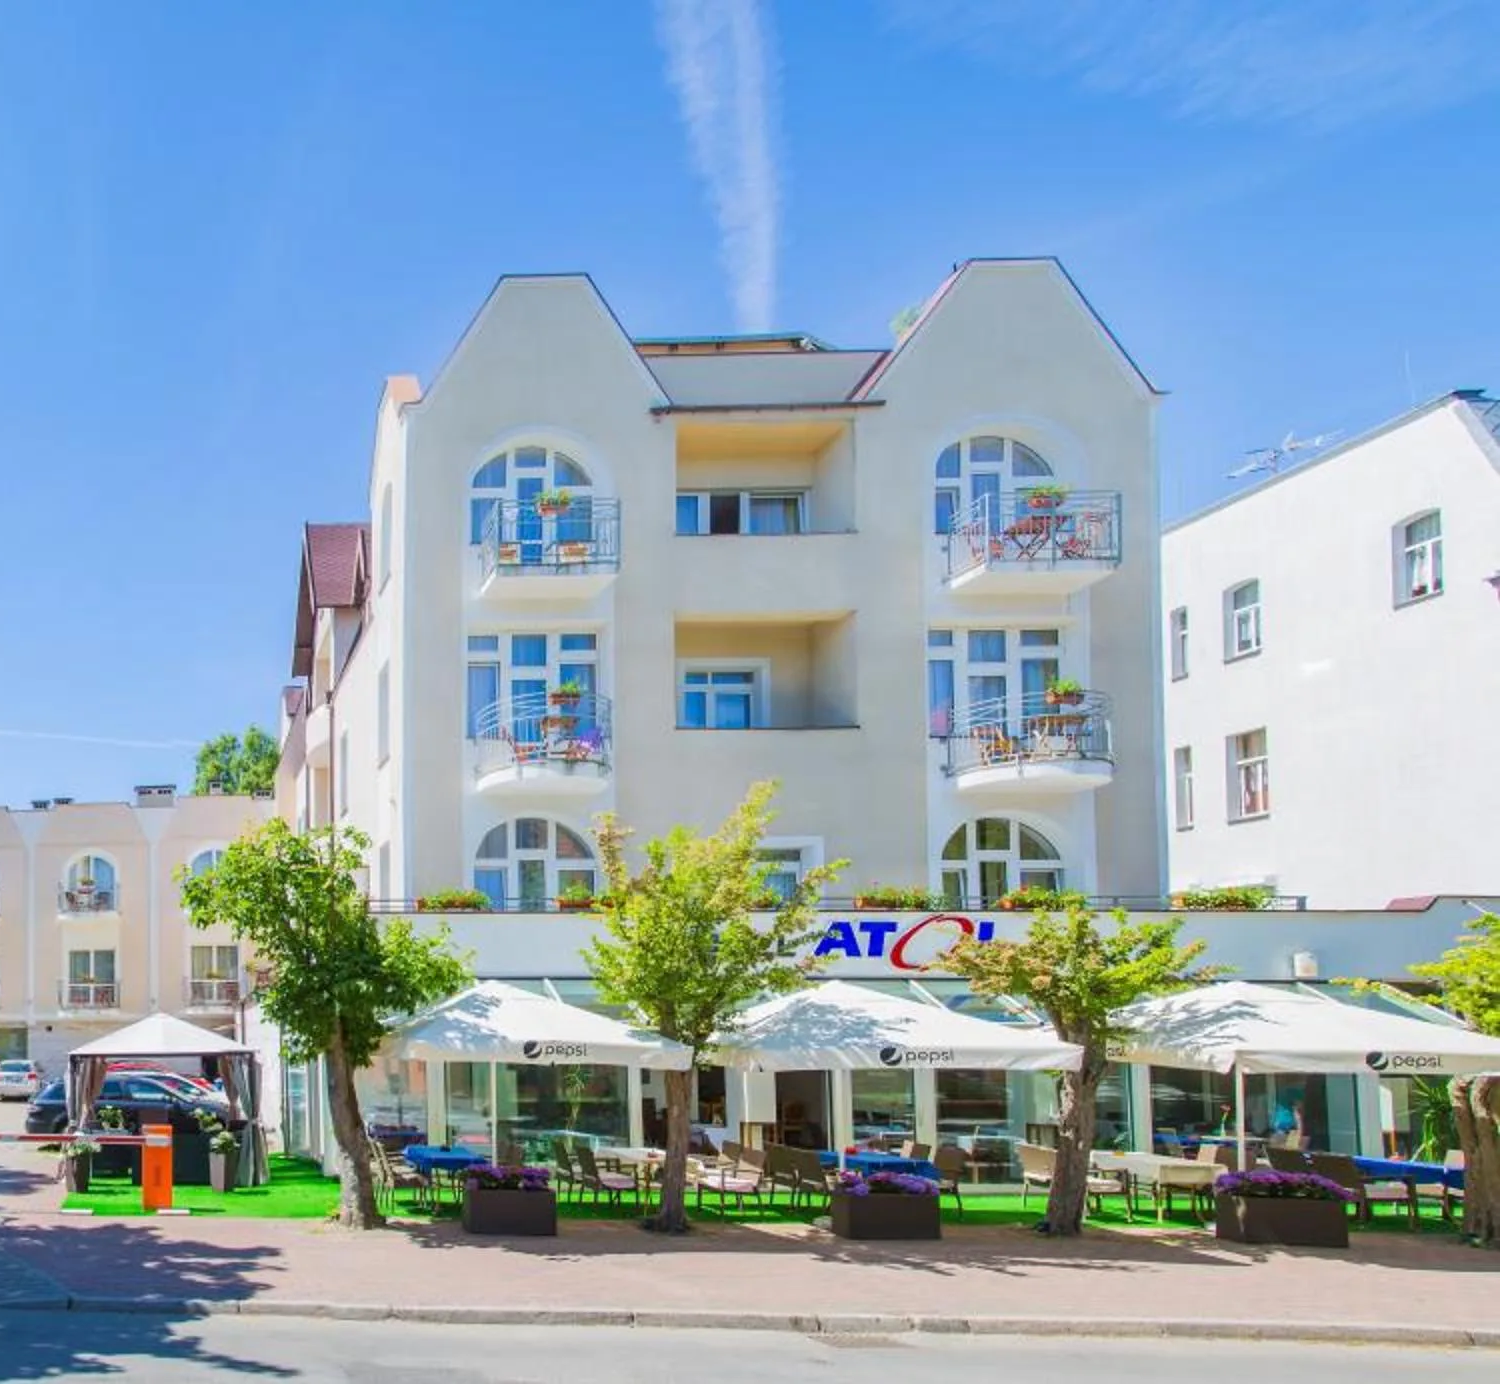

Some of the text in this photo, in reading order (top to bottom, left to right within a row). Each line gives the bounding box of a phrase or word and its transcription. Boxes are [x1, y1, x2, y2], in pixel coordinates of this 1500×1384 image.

[545, 1043, 587, 1058] pepsi
[905, 1048, 954, 1064] pepsi
[1392, 1054, 1442, 1069] pepsi
